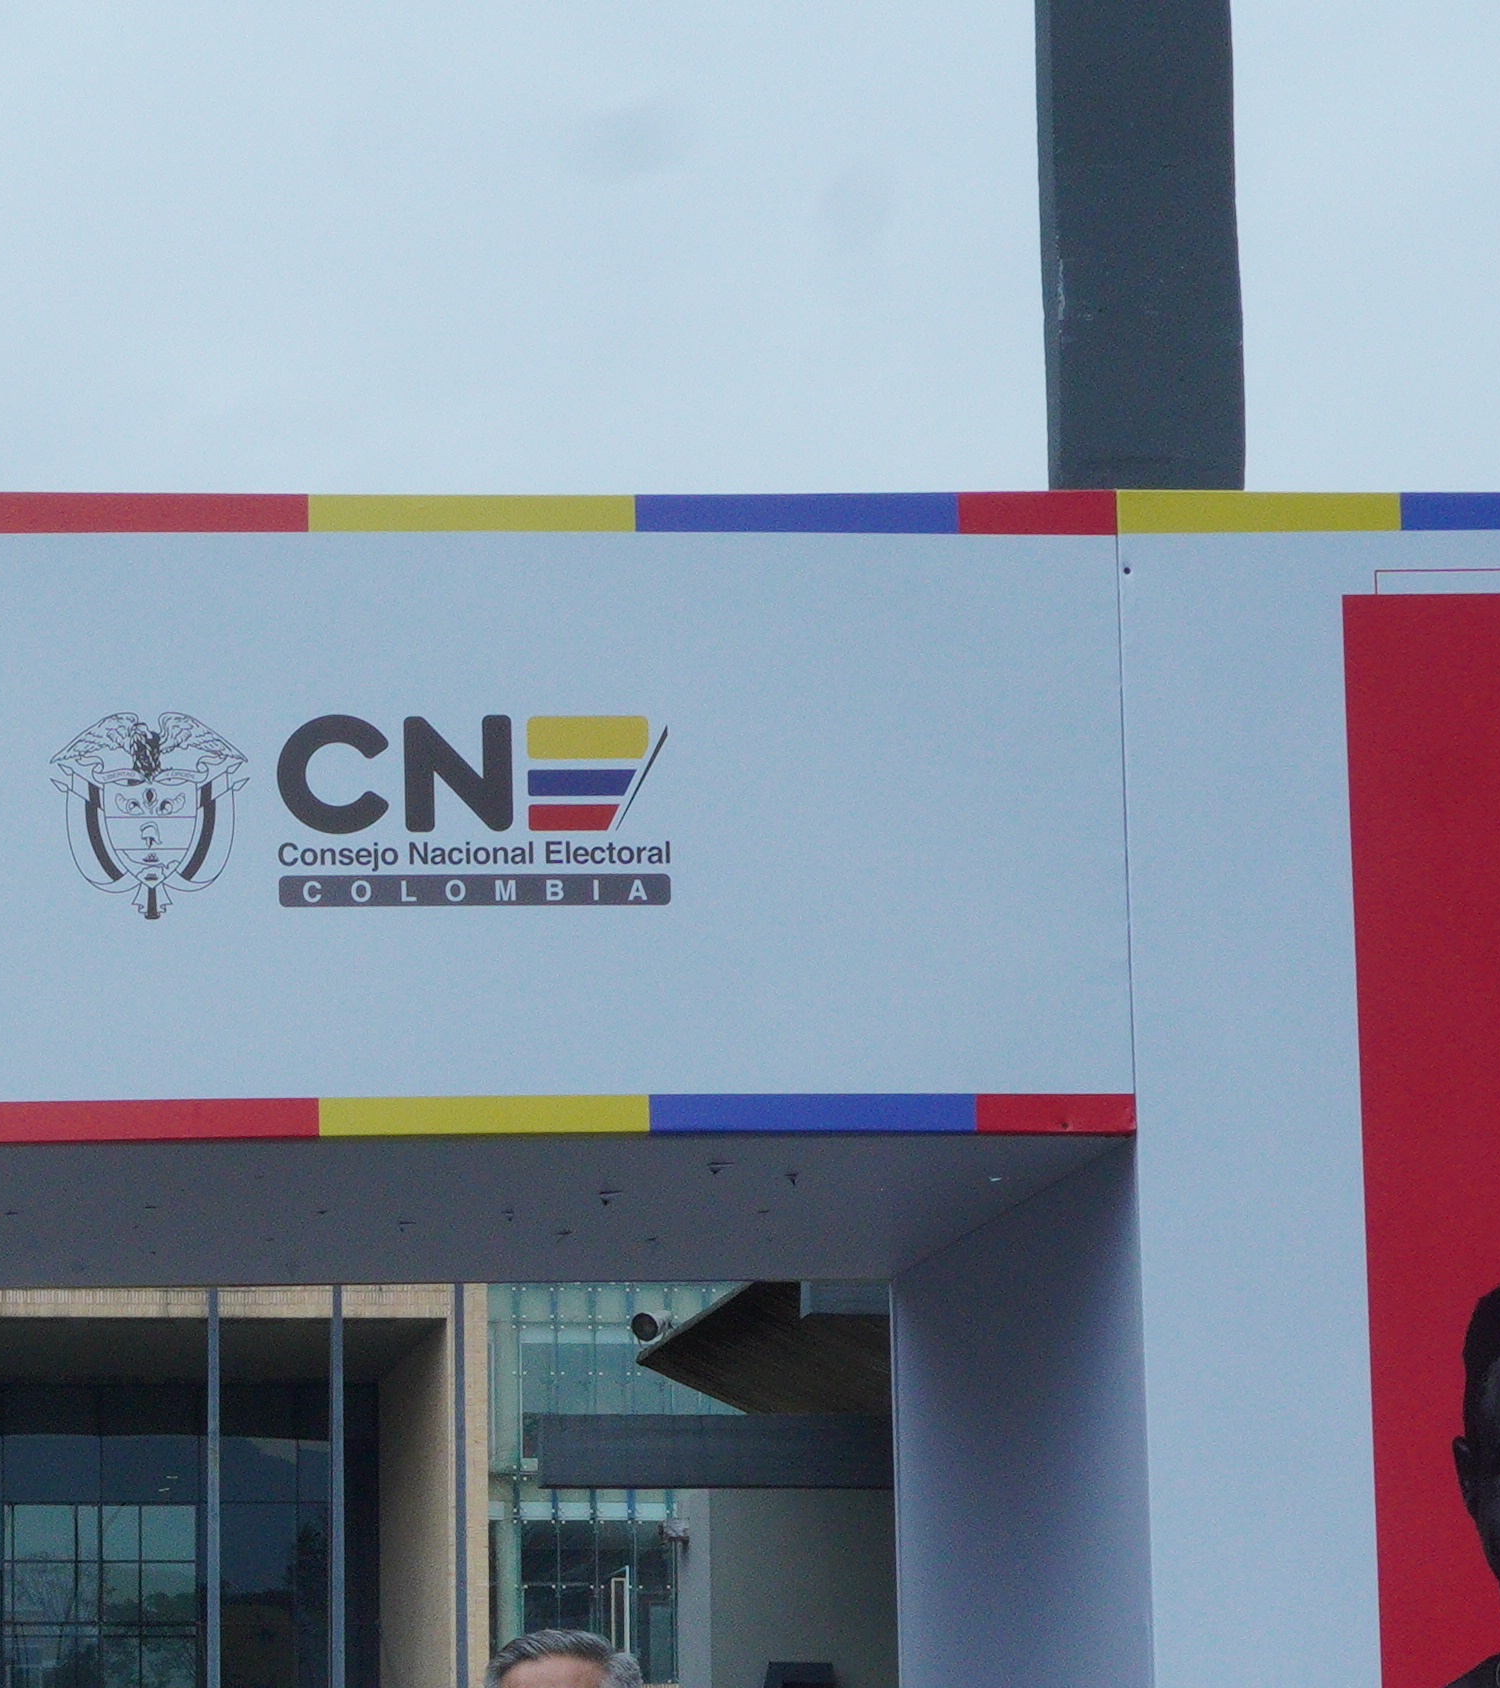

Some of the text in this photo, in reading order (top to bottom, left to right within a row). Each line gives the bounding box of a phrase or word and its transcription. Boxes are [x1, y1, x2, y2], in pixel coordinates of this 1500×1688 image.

[277, 839, 672, 874] Consejo Nacional Electoral
[302, 880, 650, 904] COLOMBIA
